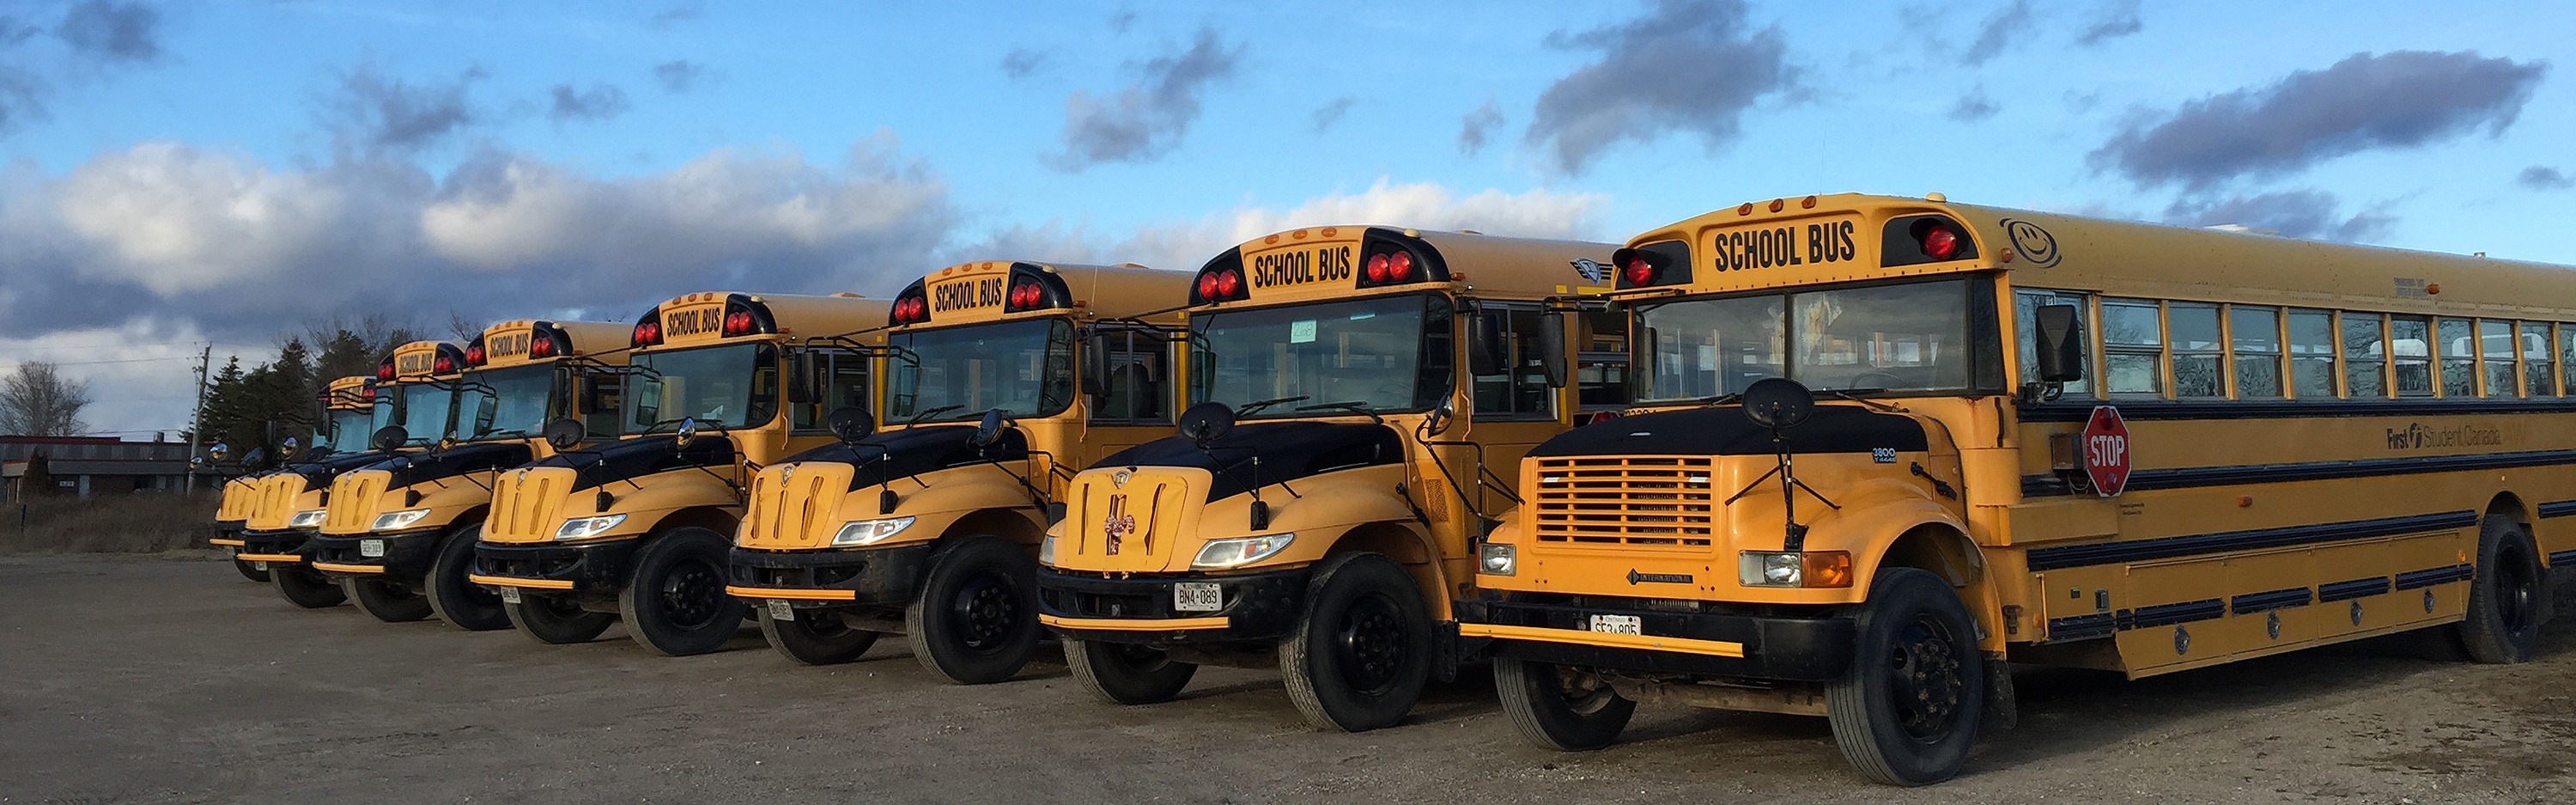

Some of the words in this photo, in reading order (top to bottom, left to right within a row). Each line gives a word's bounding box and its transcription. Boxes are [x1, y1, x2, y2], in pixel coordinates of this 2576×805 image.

[1715, 233, 1801, 272] SCHOOL
[1808, 220, 1855, 264] BUS
[1255, 251, 1314, 289] SCHOOL
[1318, 246, 1351, 282] BUS
[935, 281, 976, 313] SCHOOL
[979, 277, 1002, 308] BUS
[667, 309, 699, 338] SCHOOL
[702, 307, 720, 333] BUS
[1293, 322, 1314, 337] 268
[489, 334, 513, 358] SCHOOL
[515, 332, 529, 355] BUS
[2386, 428, 2409, 449] First
[2424, 424, 2461, 448] Student
[2465, 424, 2501, 447] Canada
[1873, 447, 1896, 457] 3800
[2090, 435, 2125, 467] STOP
[1639, 574, 1692, 582] INTERNATIONAL
